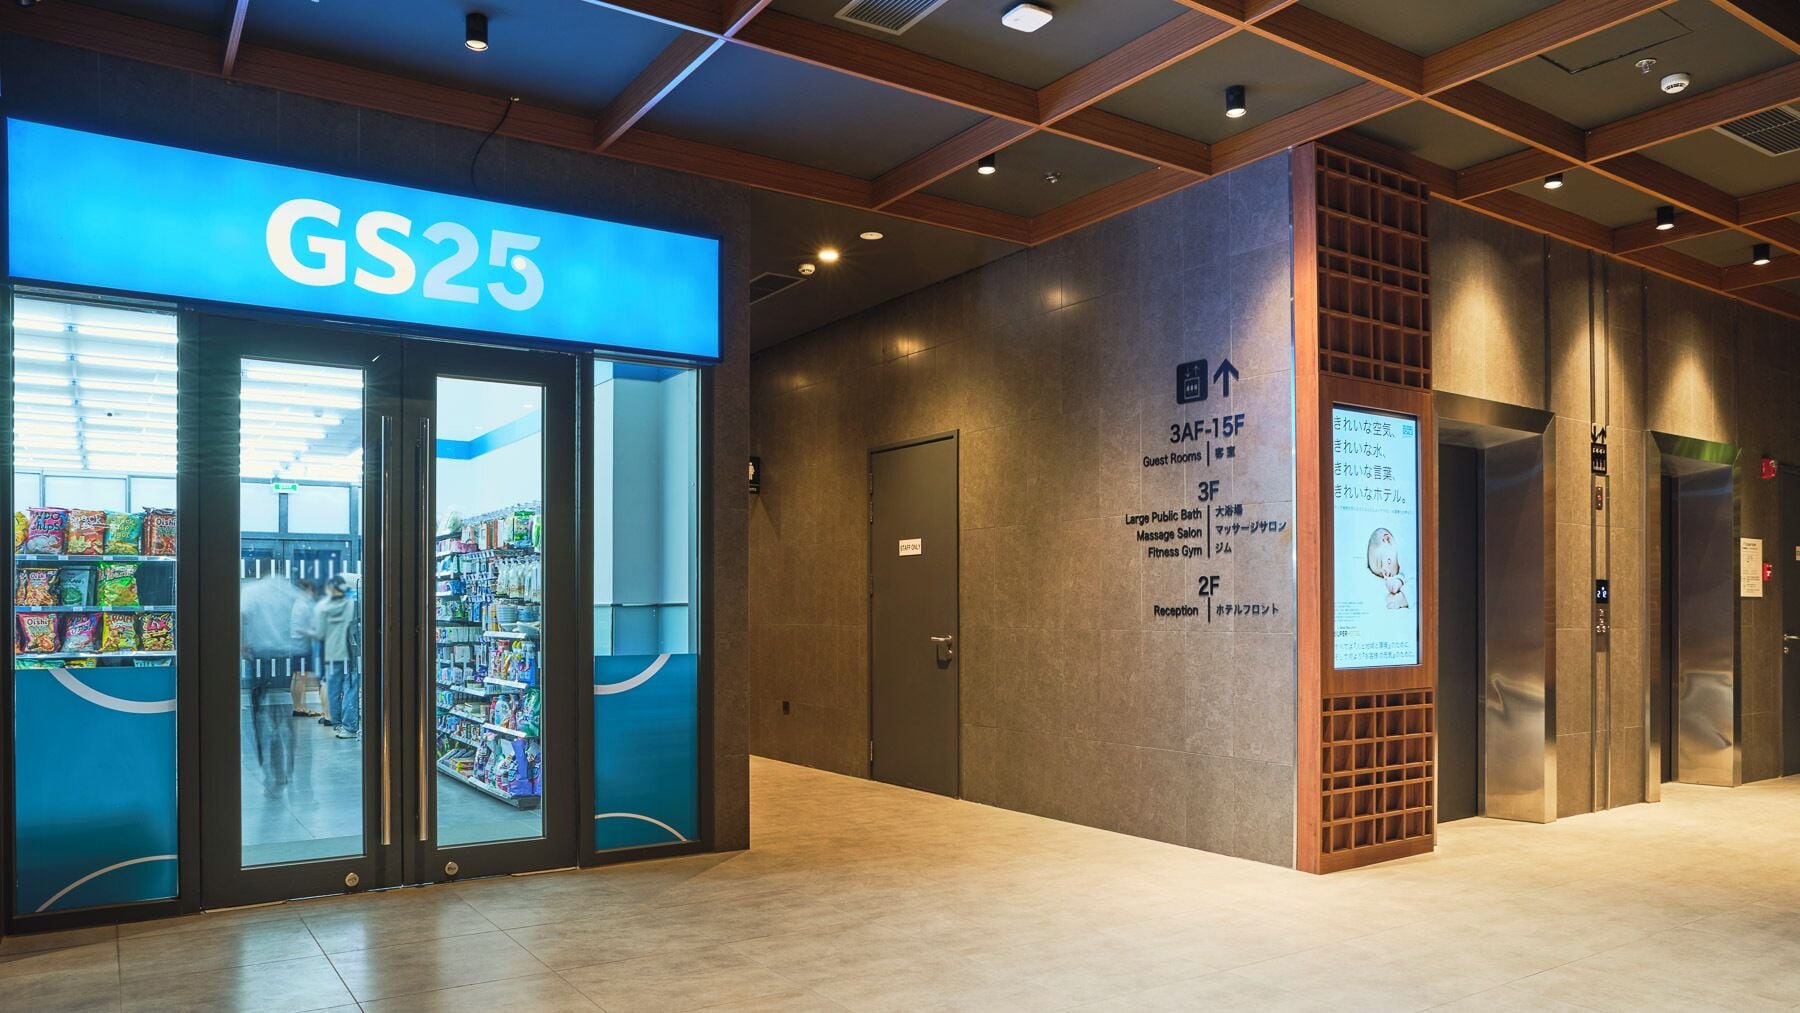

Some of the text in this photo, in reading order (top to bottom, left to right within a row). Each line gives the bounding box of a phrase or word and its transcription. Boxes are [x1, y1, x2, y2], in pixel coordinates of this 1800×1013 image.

[266, 198, 544, 311] GS25
[1170, 413, 1245, 444] 3AF-15F
[1143, 450, 1202, 468] Guest Rooms
[1198, 480, 1220, 502] 3F
[1125, 508, 1202, 527] Large Public Bath
[1215, 504, 1243, 518] 大浴場
[1137, 527, 1202, 542] Massage Salon
[1215, 521, 1287, 536] マッサージサロン
[1148, 545, 1203, 559] Fitness Gym
[1215, 542, 1232, 554] ジム
[1198, 575, 1220, 597] 2F
[1154, 605, 1199, 618] Reception
[1216, 603, 1279, 616] ホテルフロント
[27, 618, 49, 626] Oishi
